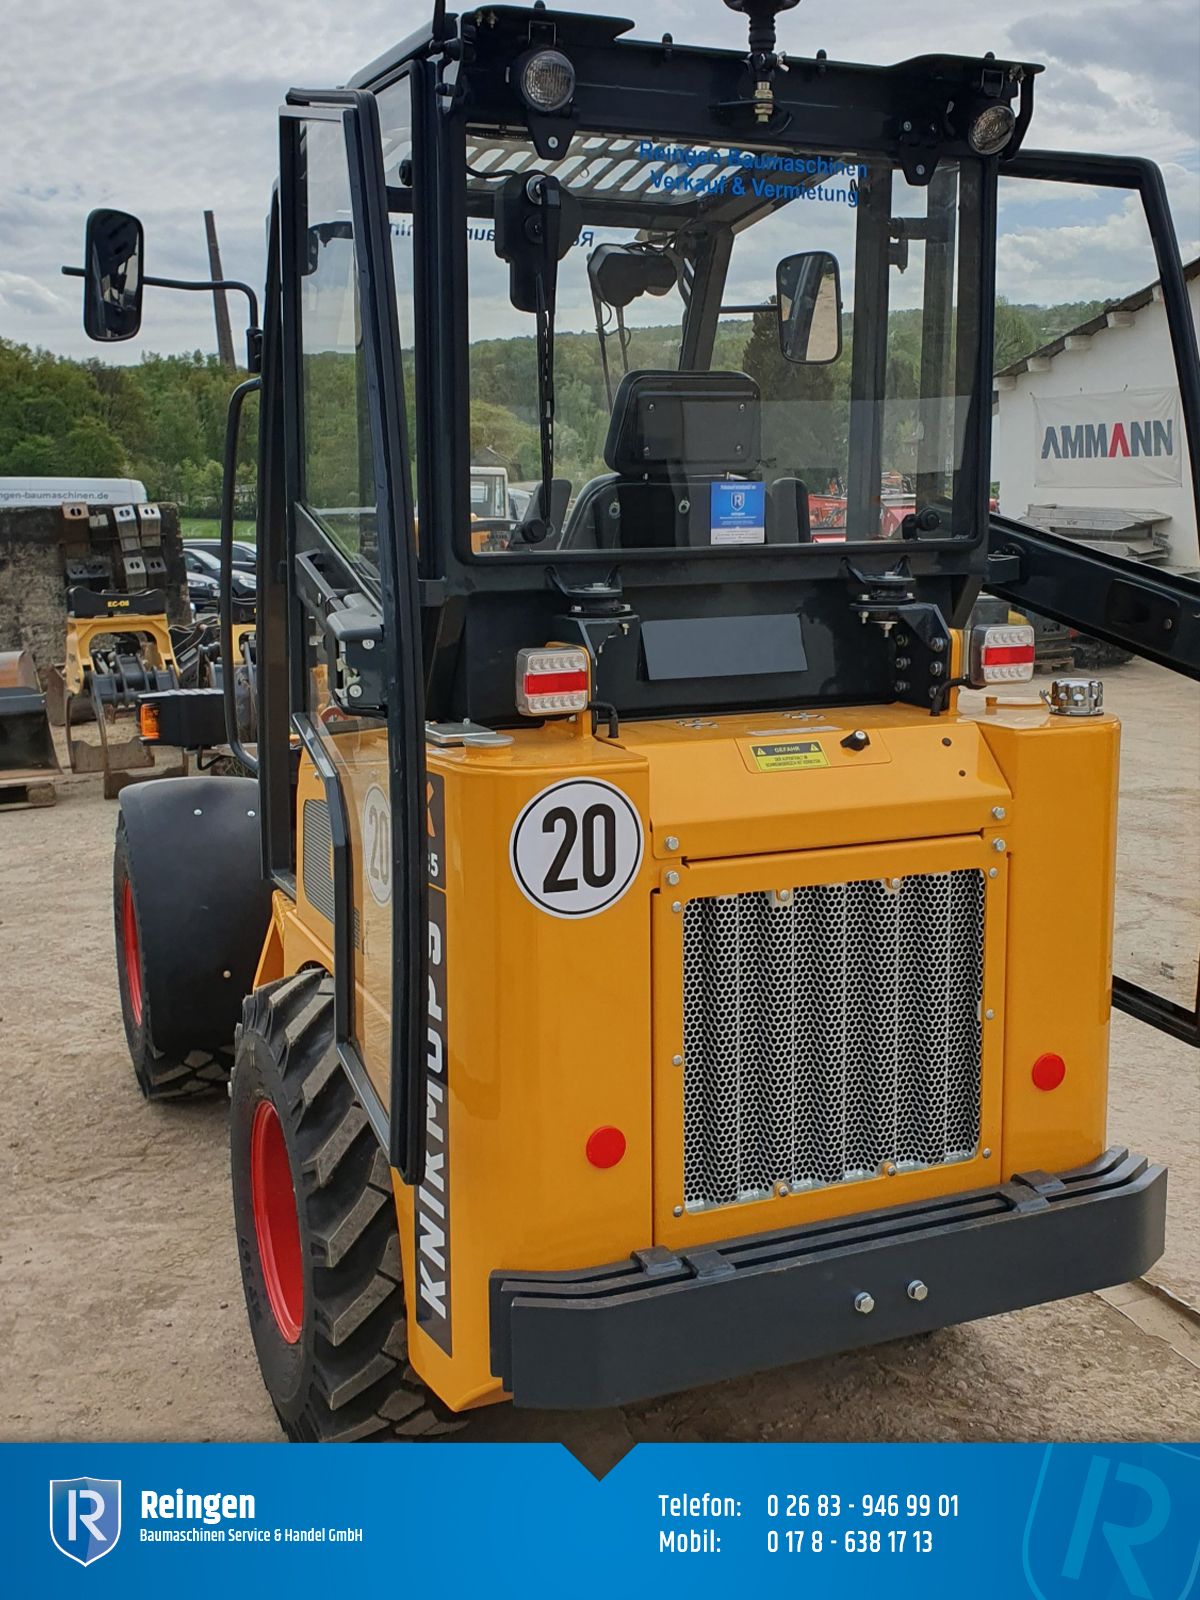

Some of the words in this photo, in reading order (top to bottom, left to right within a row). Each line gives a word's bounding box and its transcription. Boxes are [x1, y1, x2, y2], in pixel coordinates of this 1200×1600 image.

[639, 140, 721, 168] Reingen
[727, 148, 868, 178] Baumaschinen
[650, 170, 727, 194] Verkauf
[731, 177, 745, 196] &
[751, 178, 860, 208] Vermietung
[1041, 419, 1173, 459] AMMANN
[368, 805, 390, 886] 20
[542, 803, 616, 893] 20
